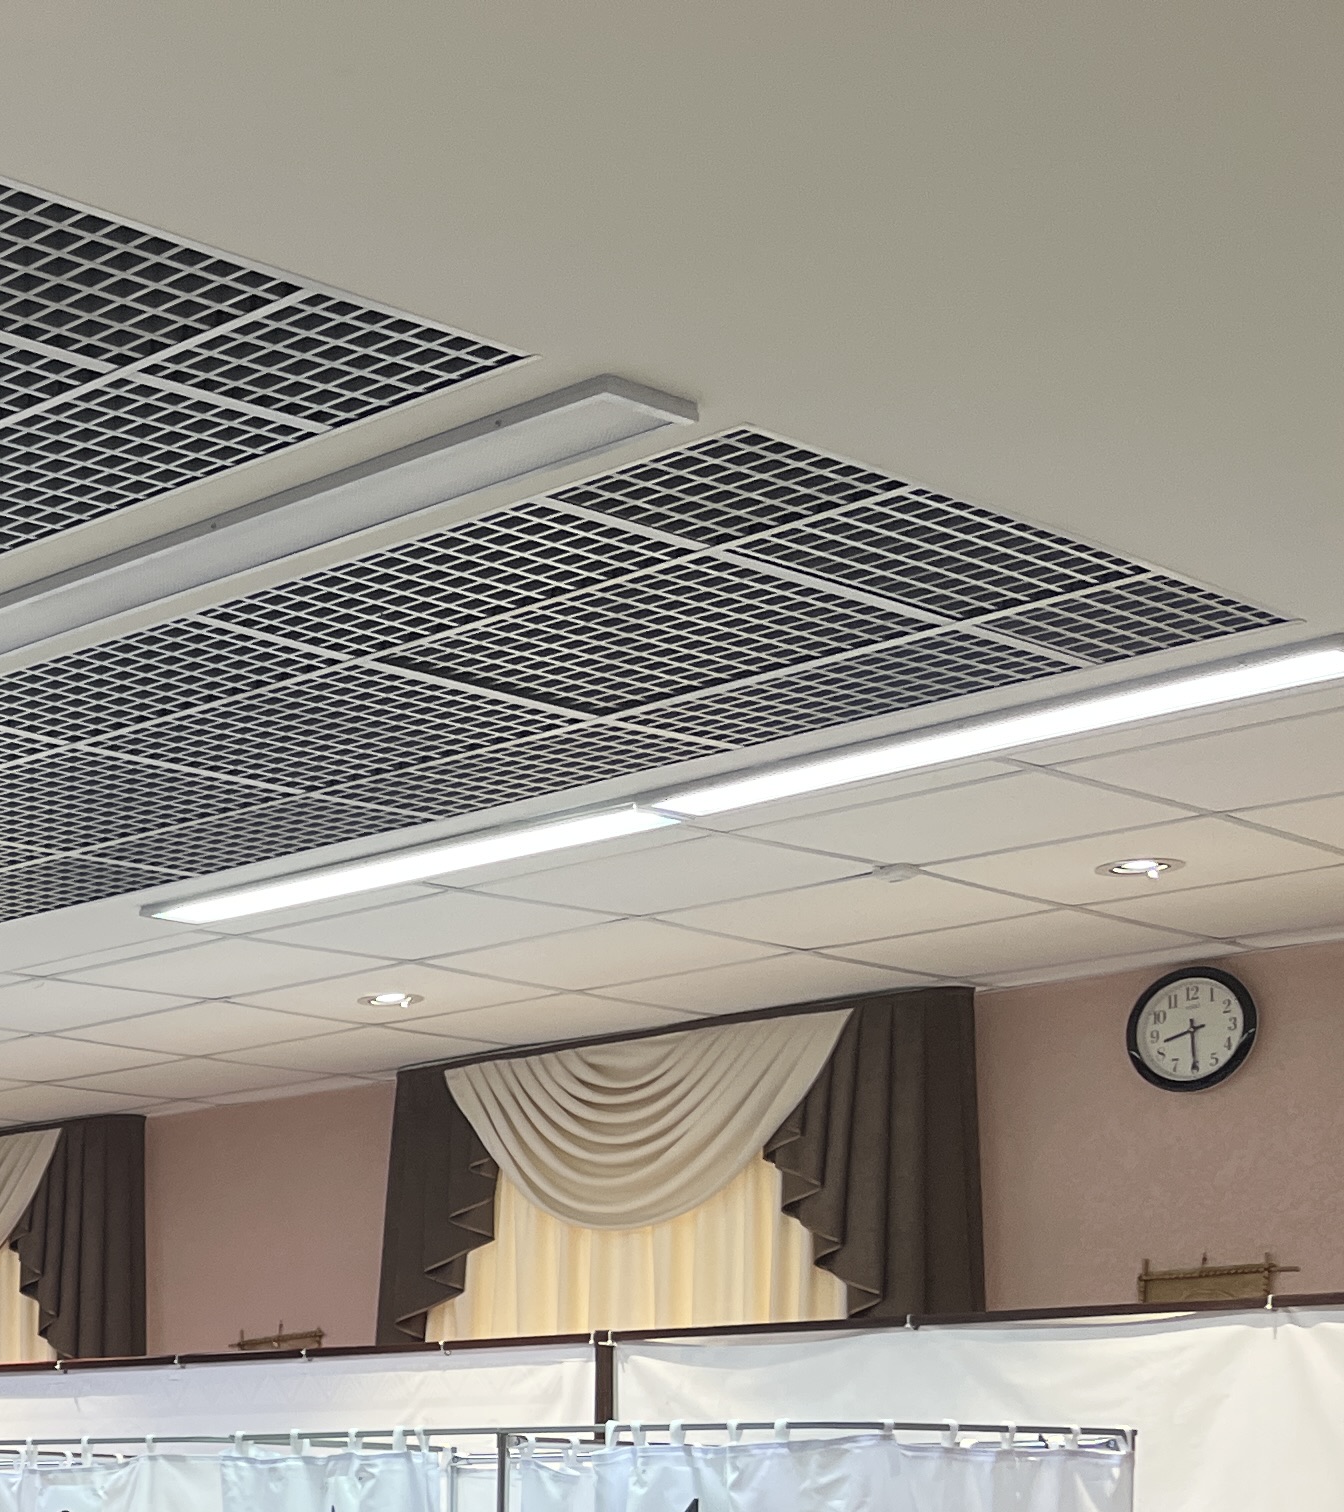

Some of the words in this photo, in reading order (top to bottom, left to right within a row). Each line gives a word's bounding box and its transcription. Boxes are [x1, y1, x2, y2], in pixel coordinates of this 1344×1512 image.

[1186, 986, 1199, 1001] 12
[1209, 987, 1215, 1002] 1
[1168, 994, 1178, 1009] 11
[1222, 999, 1231, 1013] 2
[1153, 1010, 1167, 1025] 10
[1227, 1017, 1237, 1031] 3
[1150, 1030, 1160, 1044] 9
[1224, 1036, 1232, 1051] 4
[1172, 1057, 1180, 1072] 7
[1209, 1052, 1219, 1067] 5
